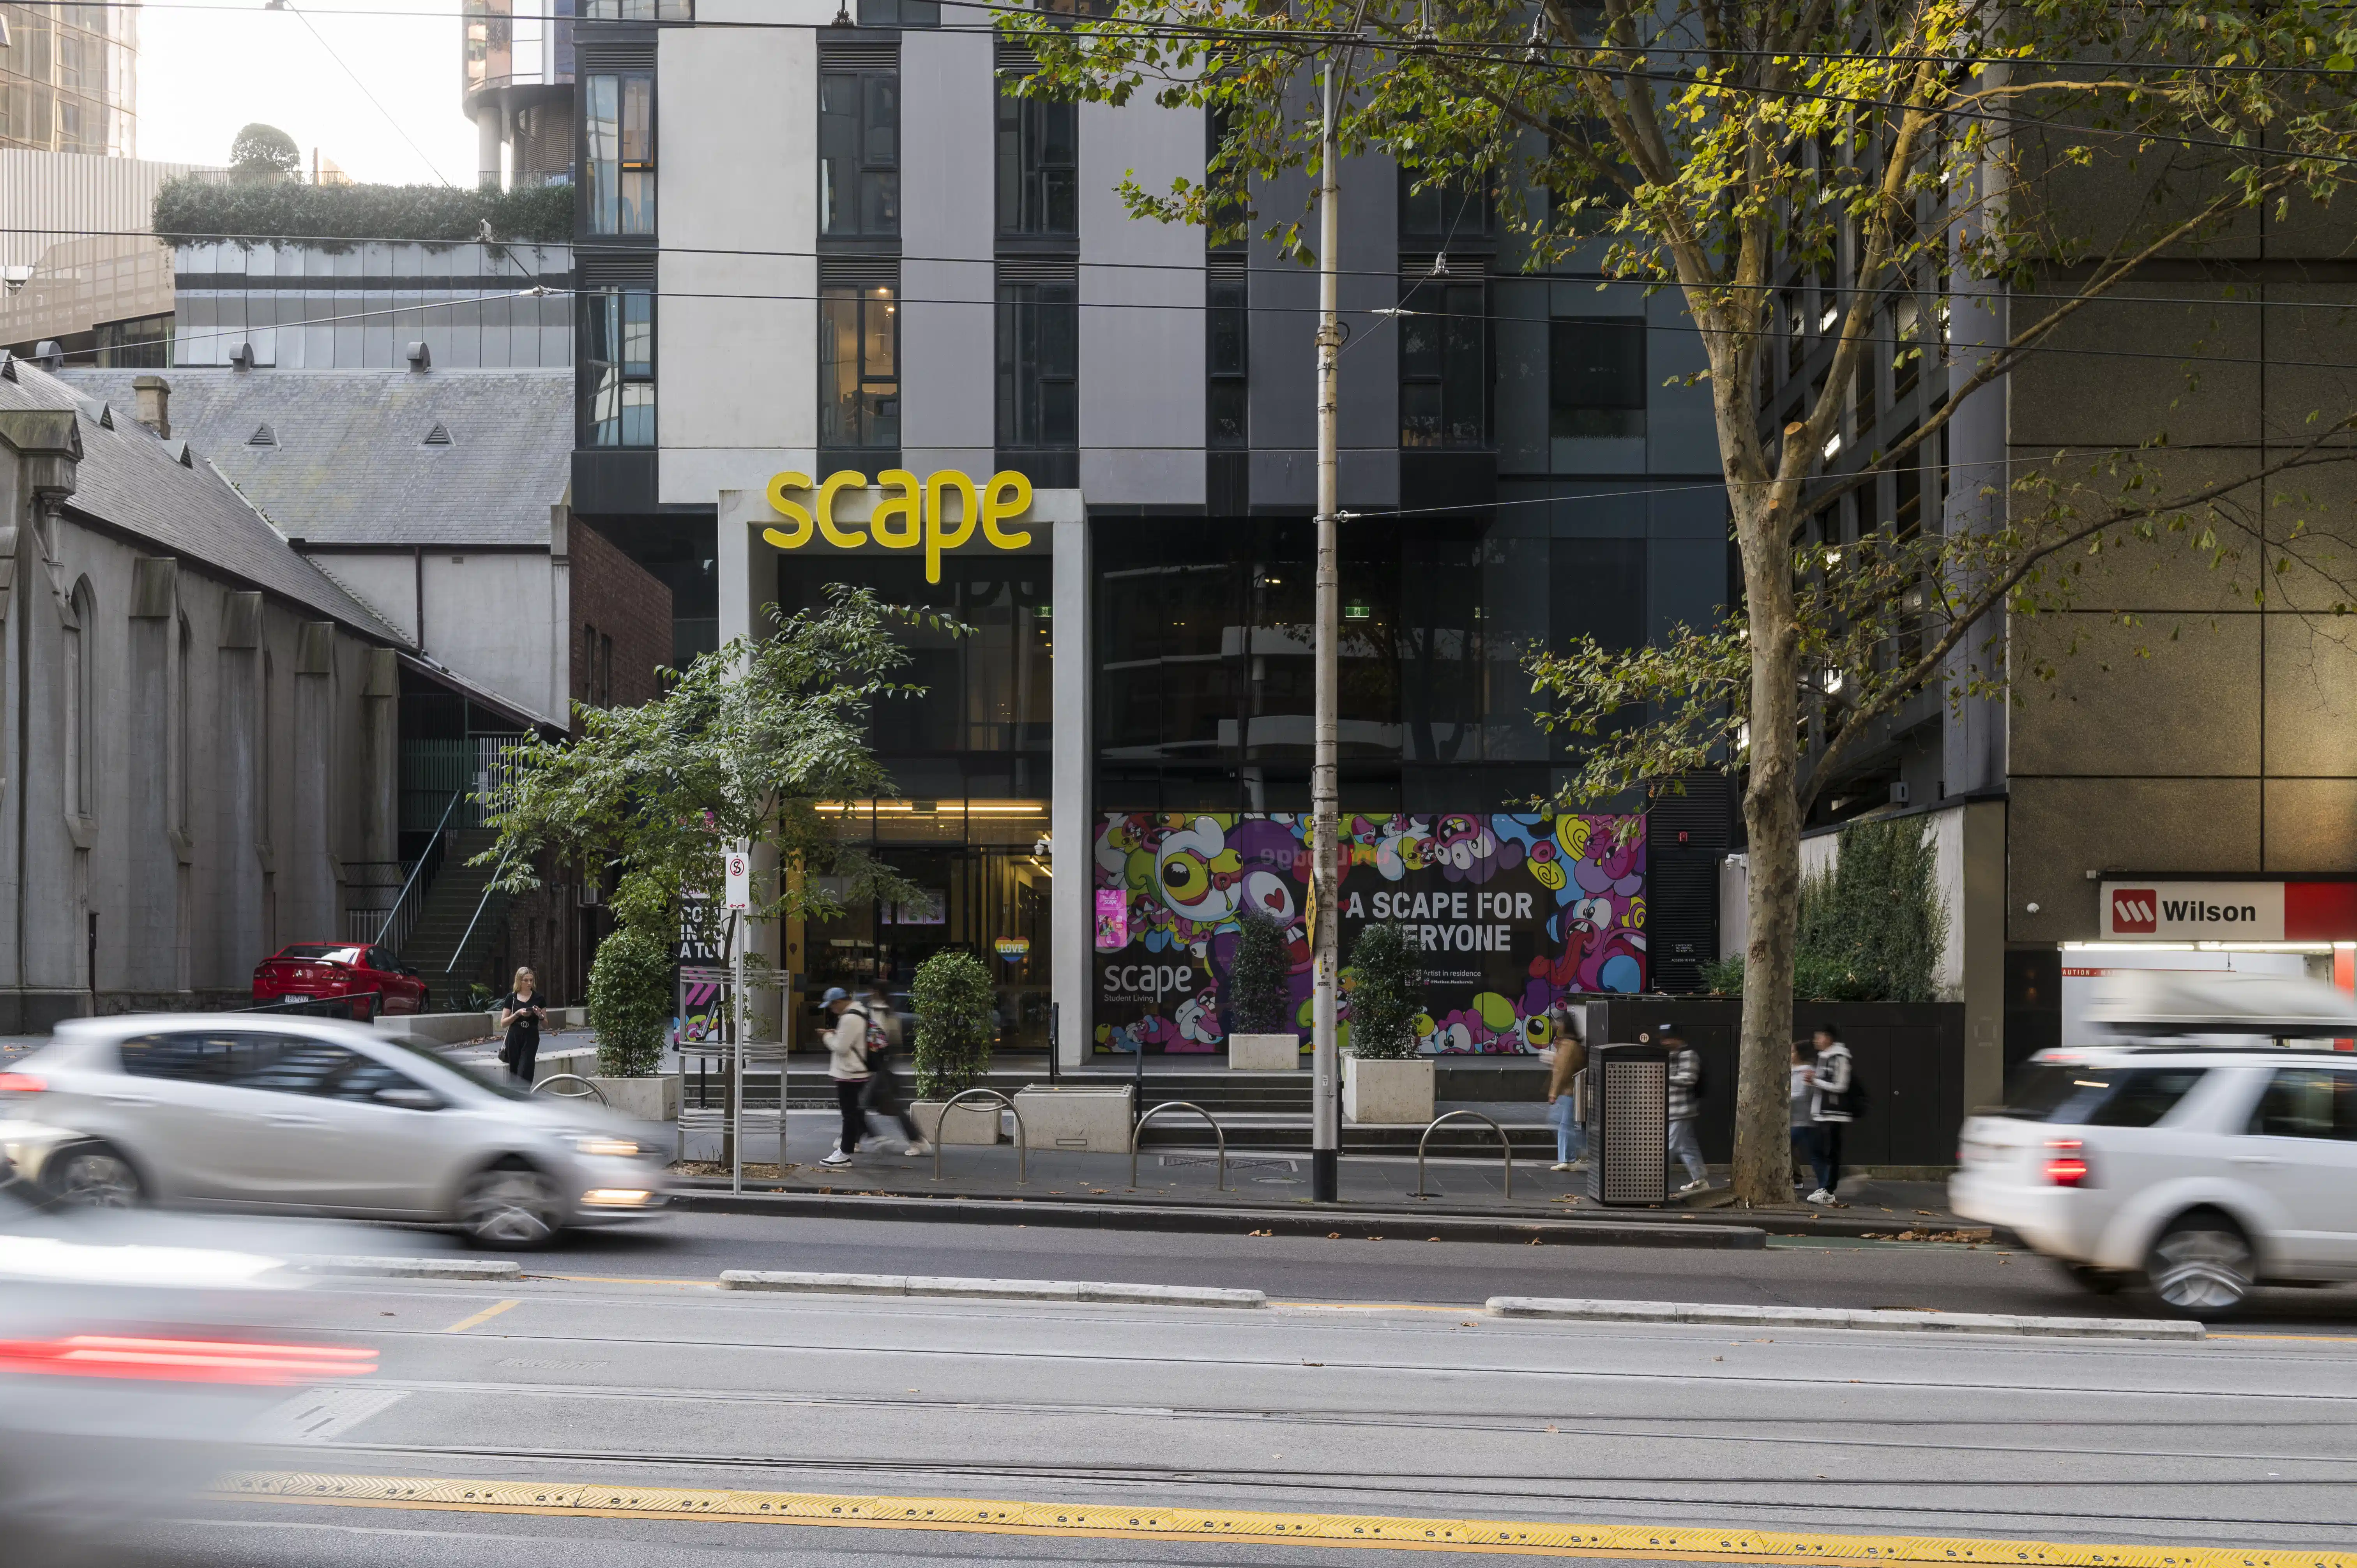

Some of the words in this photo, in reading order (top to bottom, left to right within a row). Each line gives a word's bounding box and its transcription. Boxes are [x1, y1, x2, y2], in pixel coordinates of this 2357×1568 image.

[763, 469, 1032, 584] scape
[1345, 892, 1365, 918] A
[1372, 892, 1467, 918] SCAPE
[1477, 892, 1532, 918] FOR
[2162, 901, 2256, 922] Wilson
[1000, 944, 1024, 953] LOVE
[1365, 925, 1511, 951] ERYONE
[680, 942, 691, 958] A
[1104, 965, 1192, 1003] scape
[1133, 994, 1153, 1003] Living
